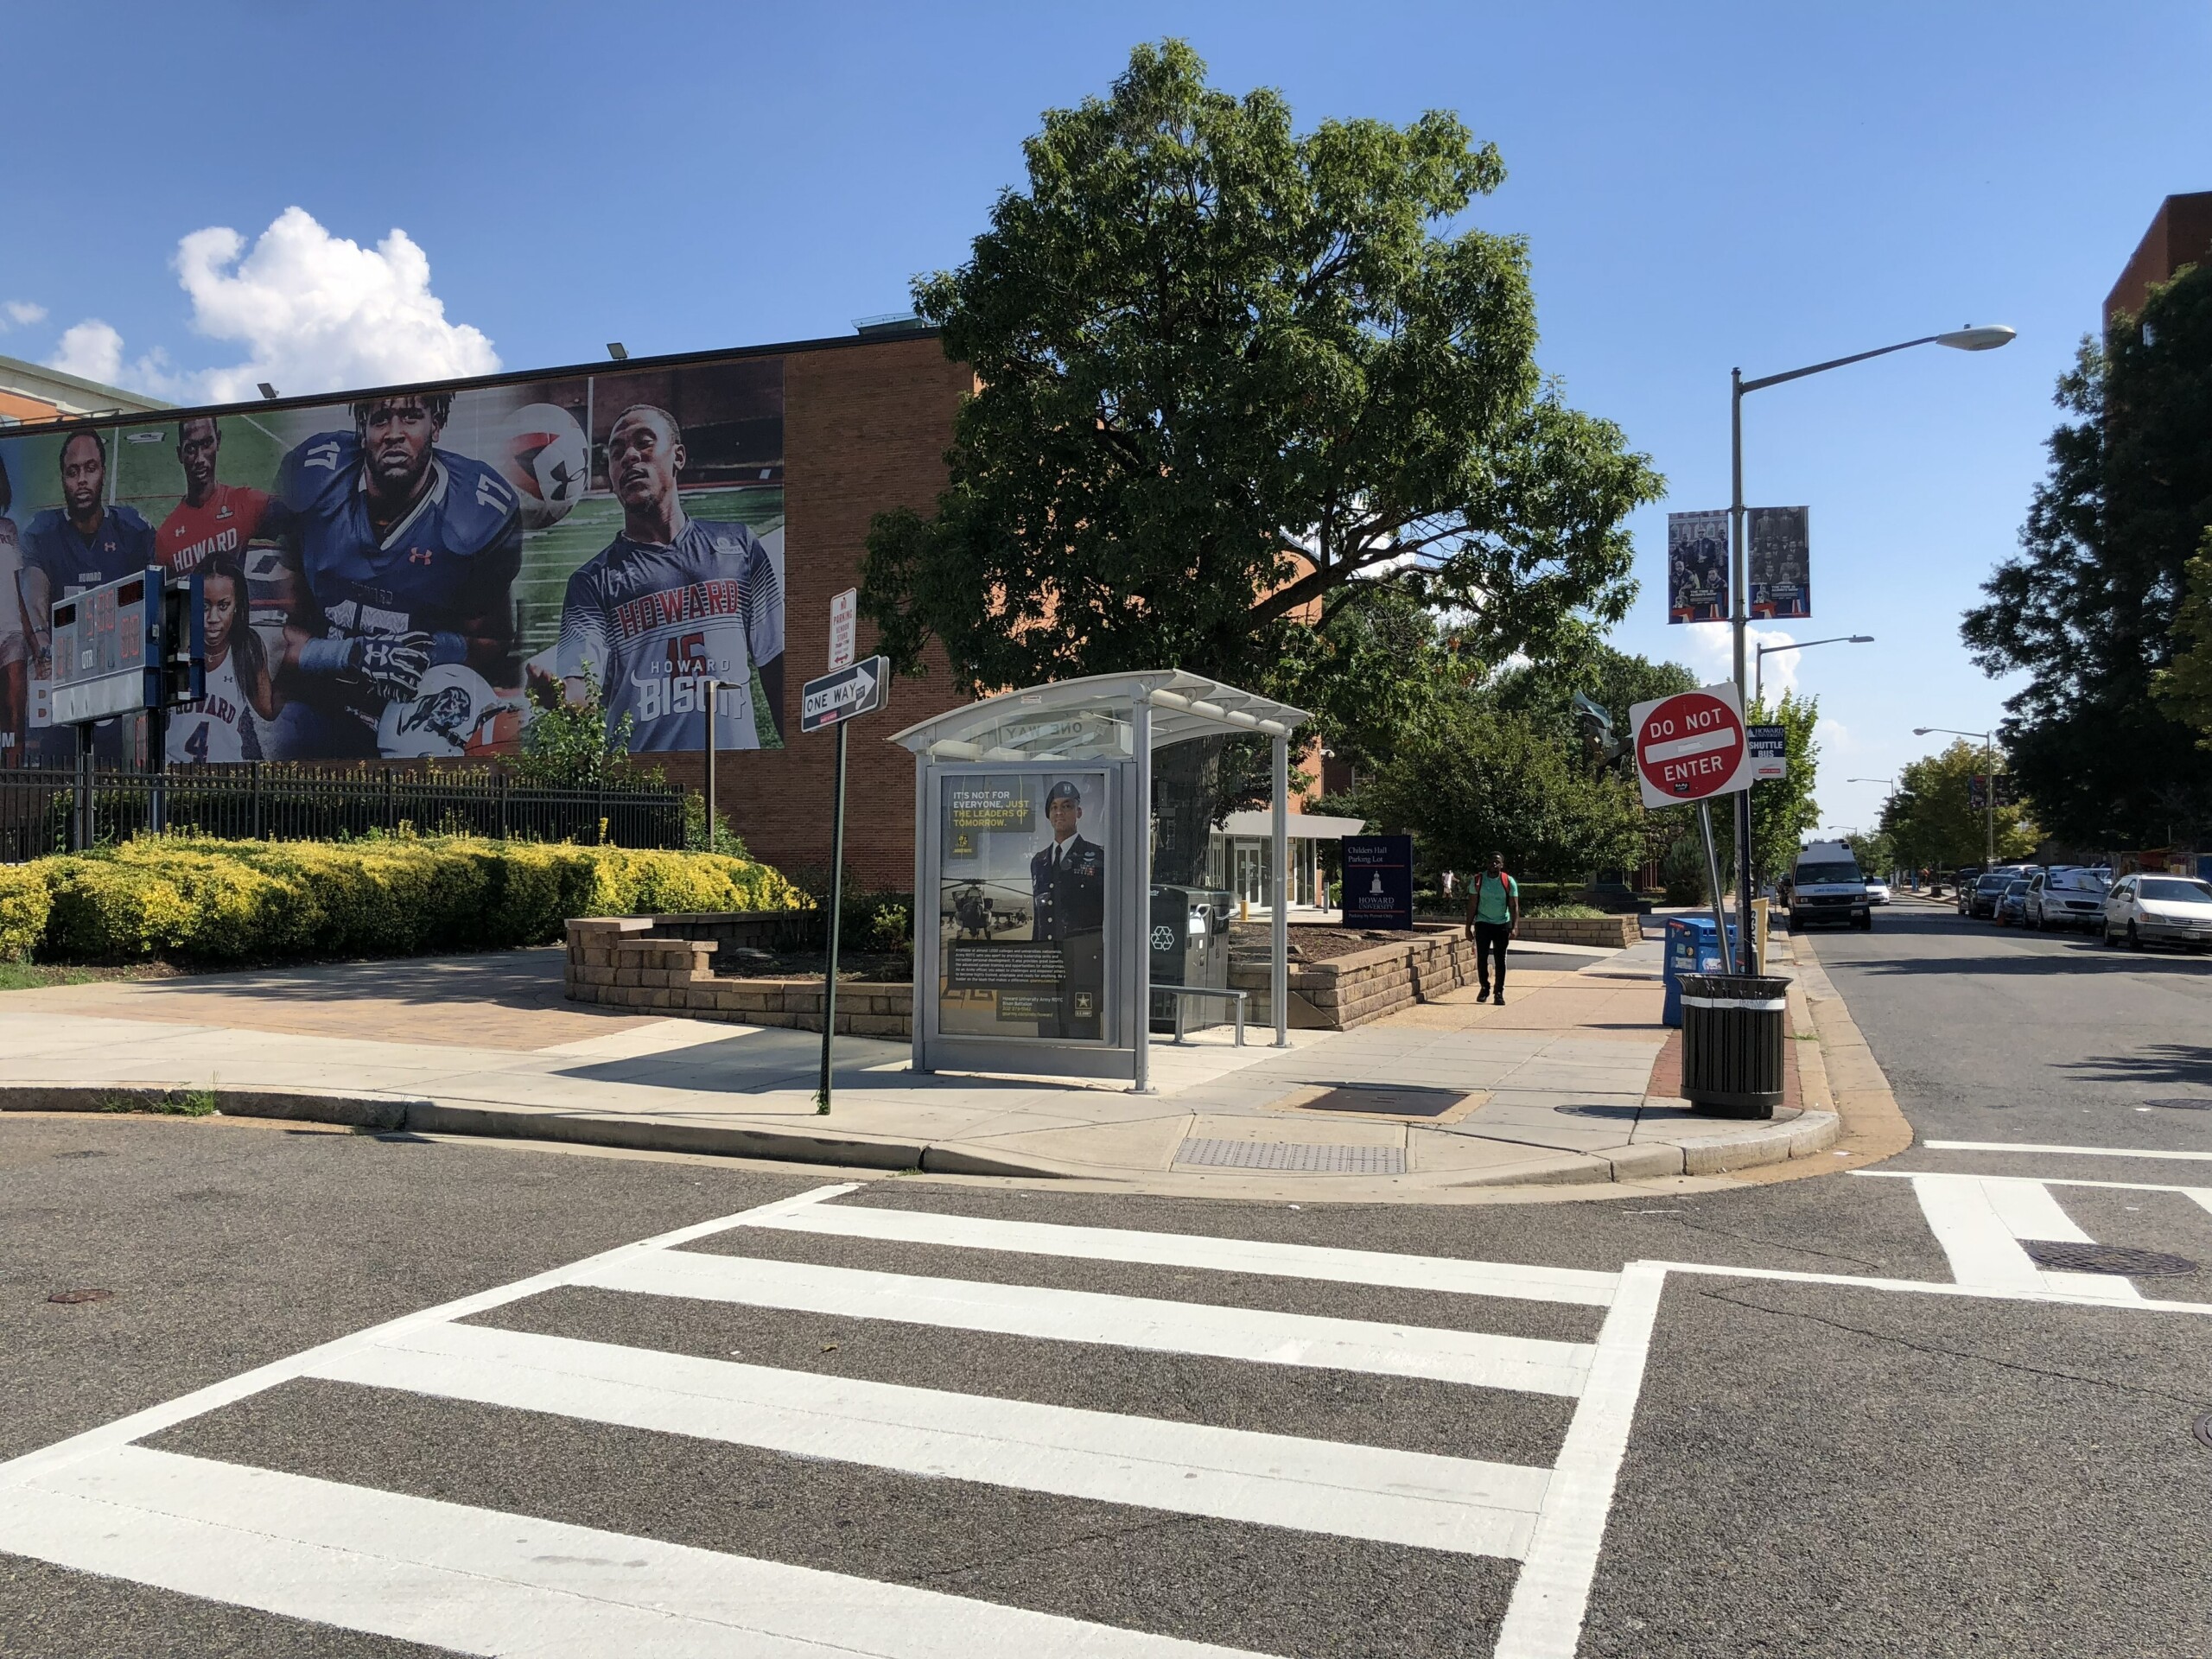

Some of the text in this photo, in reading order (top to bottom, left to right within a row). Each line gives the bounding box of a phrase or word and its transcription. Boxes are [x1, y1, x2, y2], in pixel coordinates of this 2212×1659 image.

[476, 474, 512, 516] 17
[173, 528, 237, 572] HOWARD
[79, 571, 102, 582] HOWARD
[617, 579, 738, 639] HOWARD
[840, 599, 847, 610] NO
[834, 609, 852, 626] PARKING
[81, 649, 93, 671] QTR
[652, 658, 730, 674] HOWARD
[635, 675, 746, 721] BISON
[807, 693, 828, 713] ONE
[834, 682, 856, 703] WAY
[1649, 708, 1721, 739] DO NOT
[1748, 741, 1783, 750] SHUTTLE
[1758, 749, 1775, 758] BUS
[1663, 755, 1724, 782] ENTER
[992, 791, 1010, 799] FOR
[953, 800, 1003, 809] EVERYONE,
[1016, 809, 1029, 817] OF
[953, 818, 1007, 827] TOMORROW.
